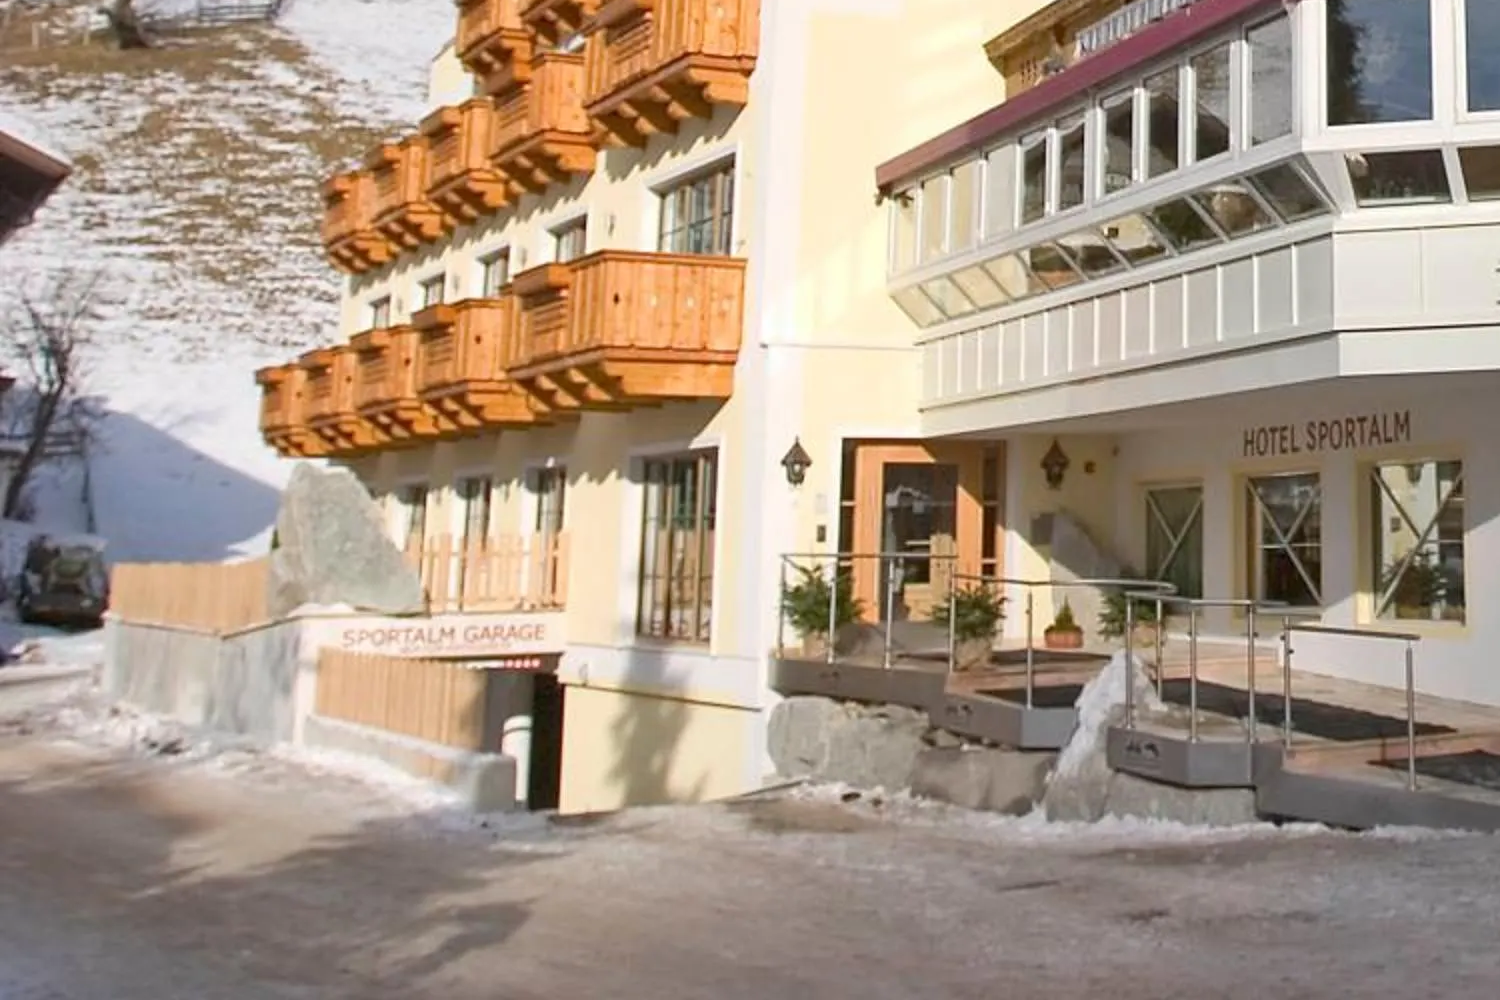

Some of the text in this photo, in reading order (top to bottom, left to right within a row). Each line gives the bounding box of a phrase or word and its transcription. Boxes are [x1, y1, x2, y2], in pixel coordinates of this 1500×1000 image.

[1243, 408, 1411, 457] HOTEL SPORTALM
[342, 627, 456, 647] SPORTALM
[463, 622, 546, 642] GARAGE
